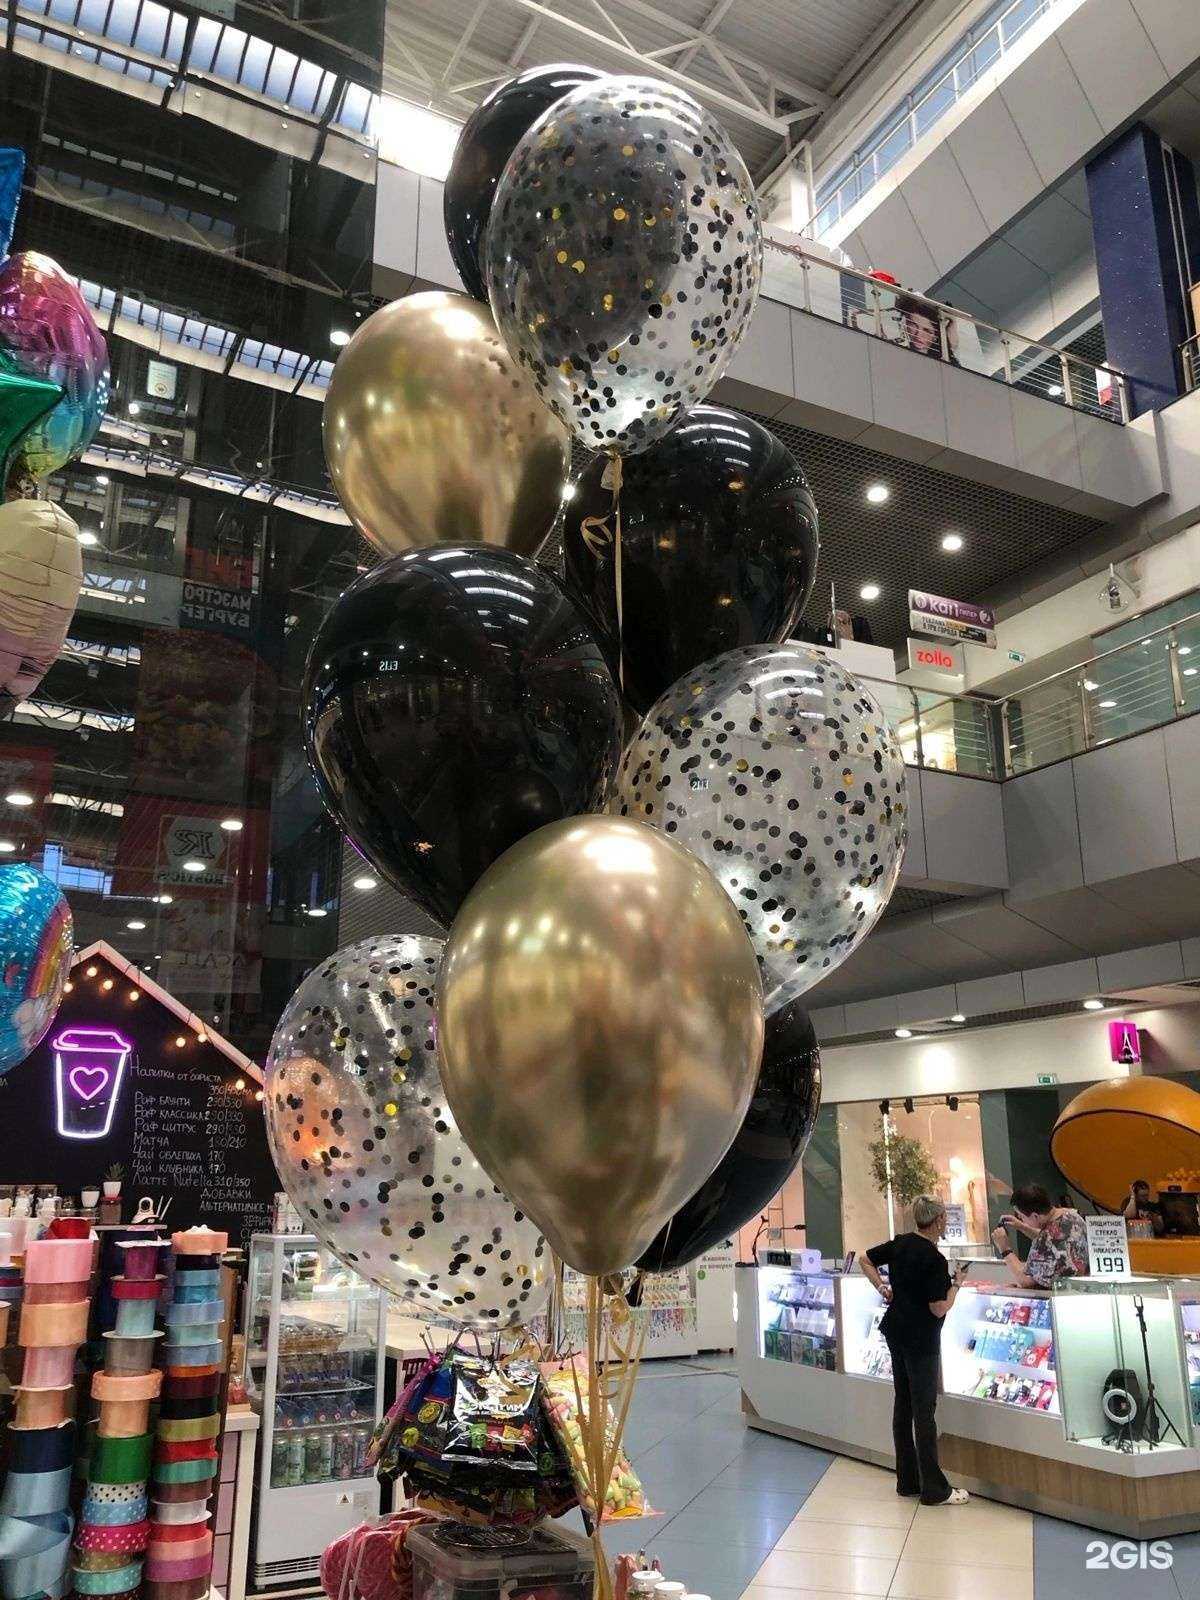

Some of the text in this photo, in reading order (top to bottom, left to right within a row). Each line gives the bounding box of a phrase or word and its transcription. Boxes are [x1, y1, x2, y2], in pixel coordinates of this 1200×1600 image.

[930, 598, 959, 617] kari
[917, 650, 952, 667] zolla
[1096, 1257, 1124, 1272] 199
